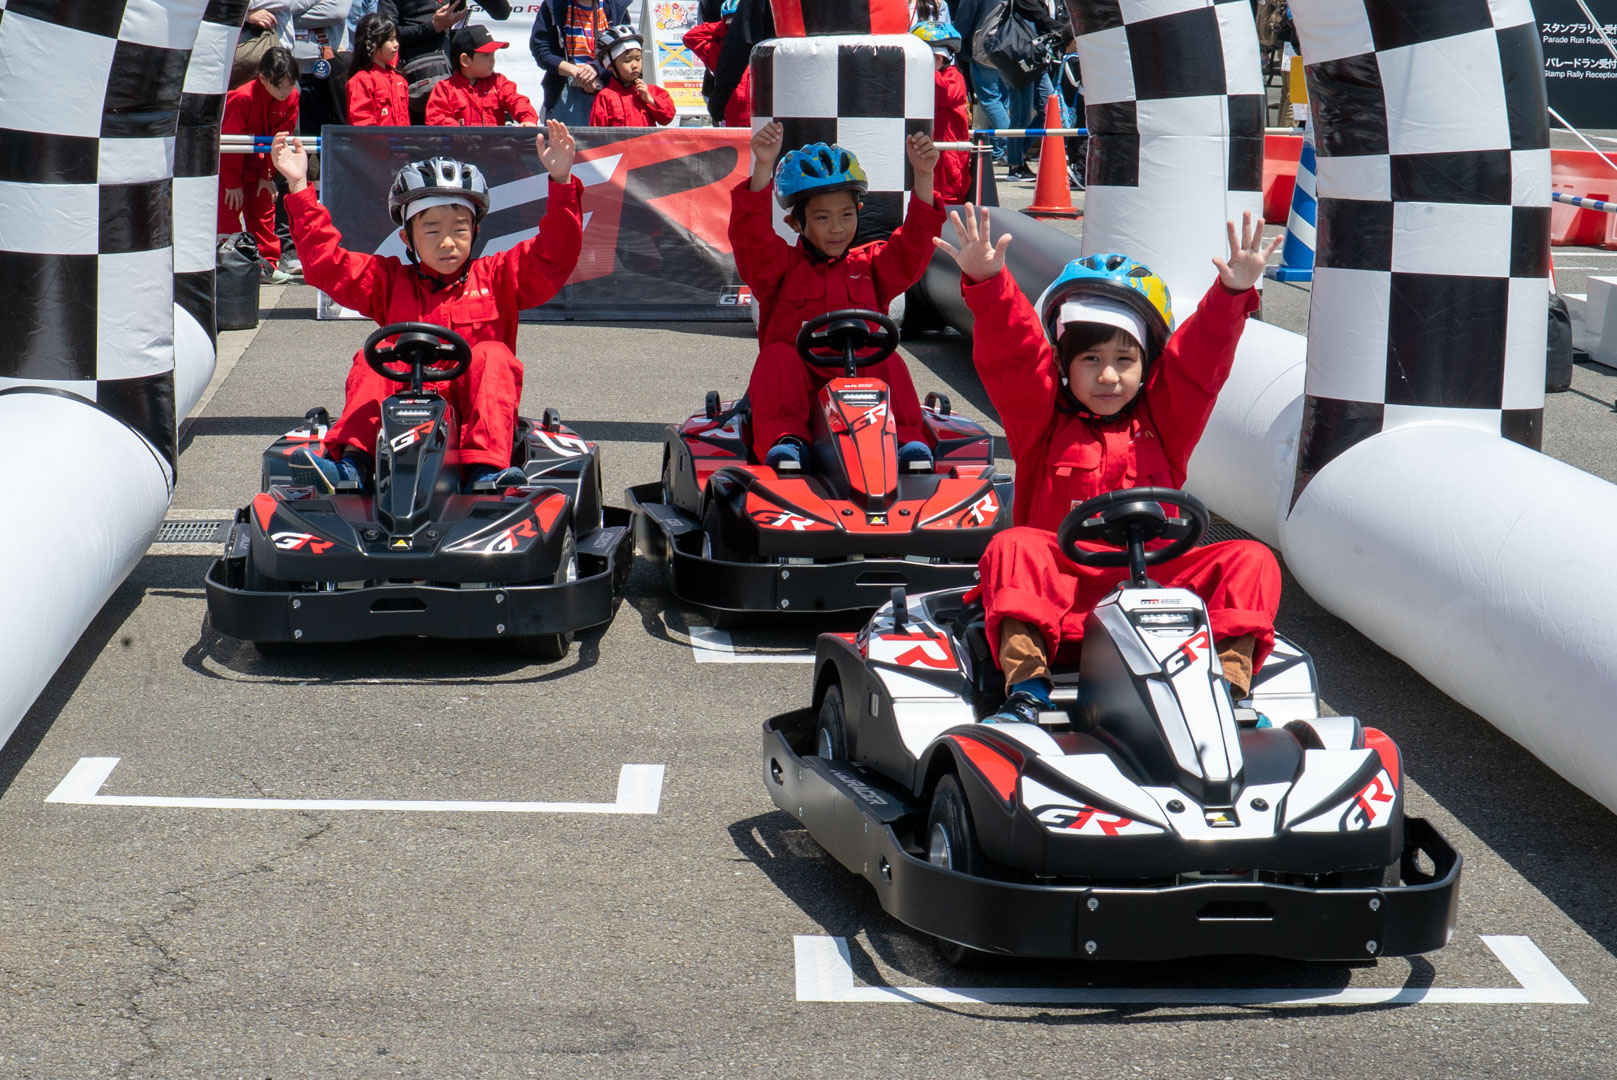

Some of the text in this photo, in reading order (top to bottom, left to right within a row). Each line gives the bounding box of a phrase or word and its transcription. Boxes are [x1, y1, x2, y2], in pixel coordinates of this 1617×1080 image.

[1543, 35, 1568, 43] Parade
[1570, 36, 1585, 44] Run
[1544, 69, 1565, 79] Stamp
[1567, 70, 1584, 79] Rally
[1545, 57, 1617, 69] パレードラン受付
[850, 403, 887, 432] GR
[390, 419, 436, 452] GR
[751, 509, 816, 531] GR
[955, 493, 1000, 528] GR
[270, 531, 335, 554] GR
[484, 517, 538, 554] GR
[1160, 631, 1210, 679] GR
[1338, 775, 1395, 832] GR
[1030, 804, 1134, 836] GR
